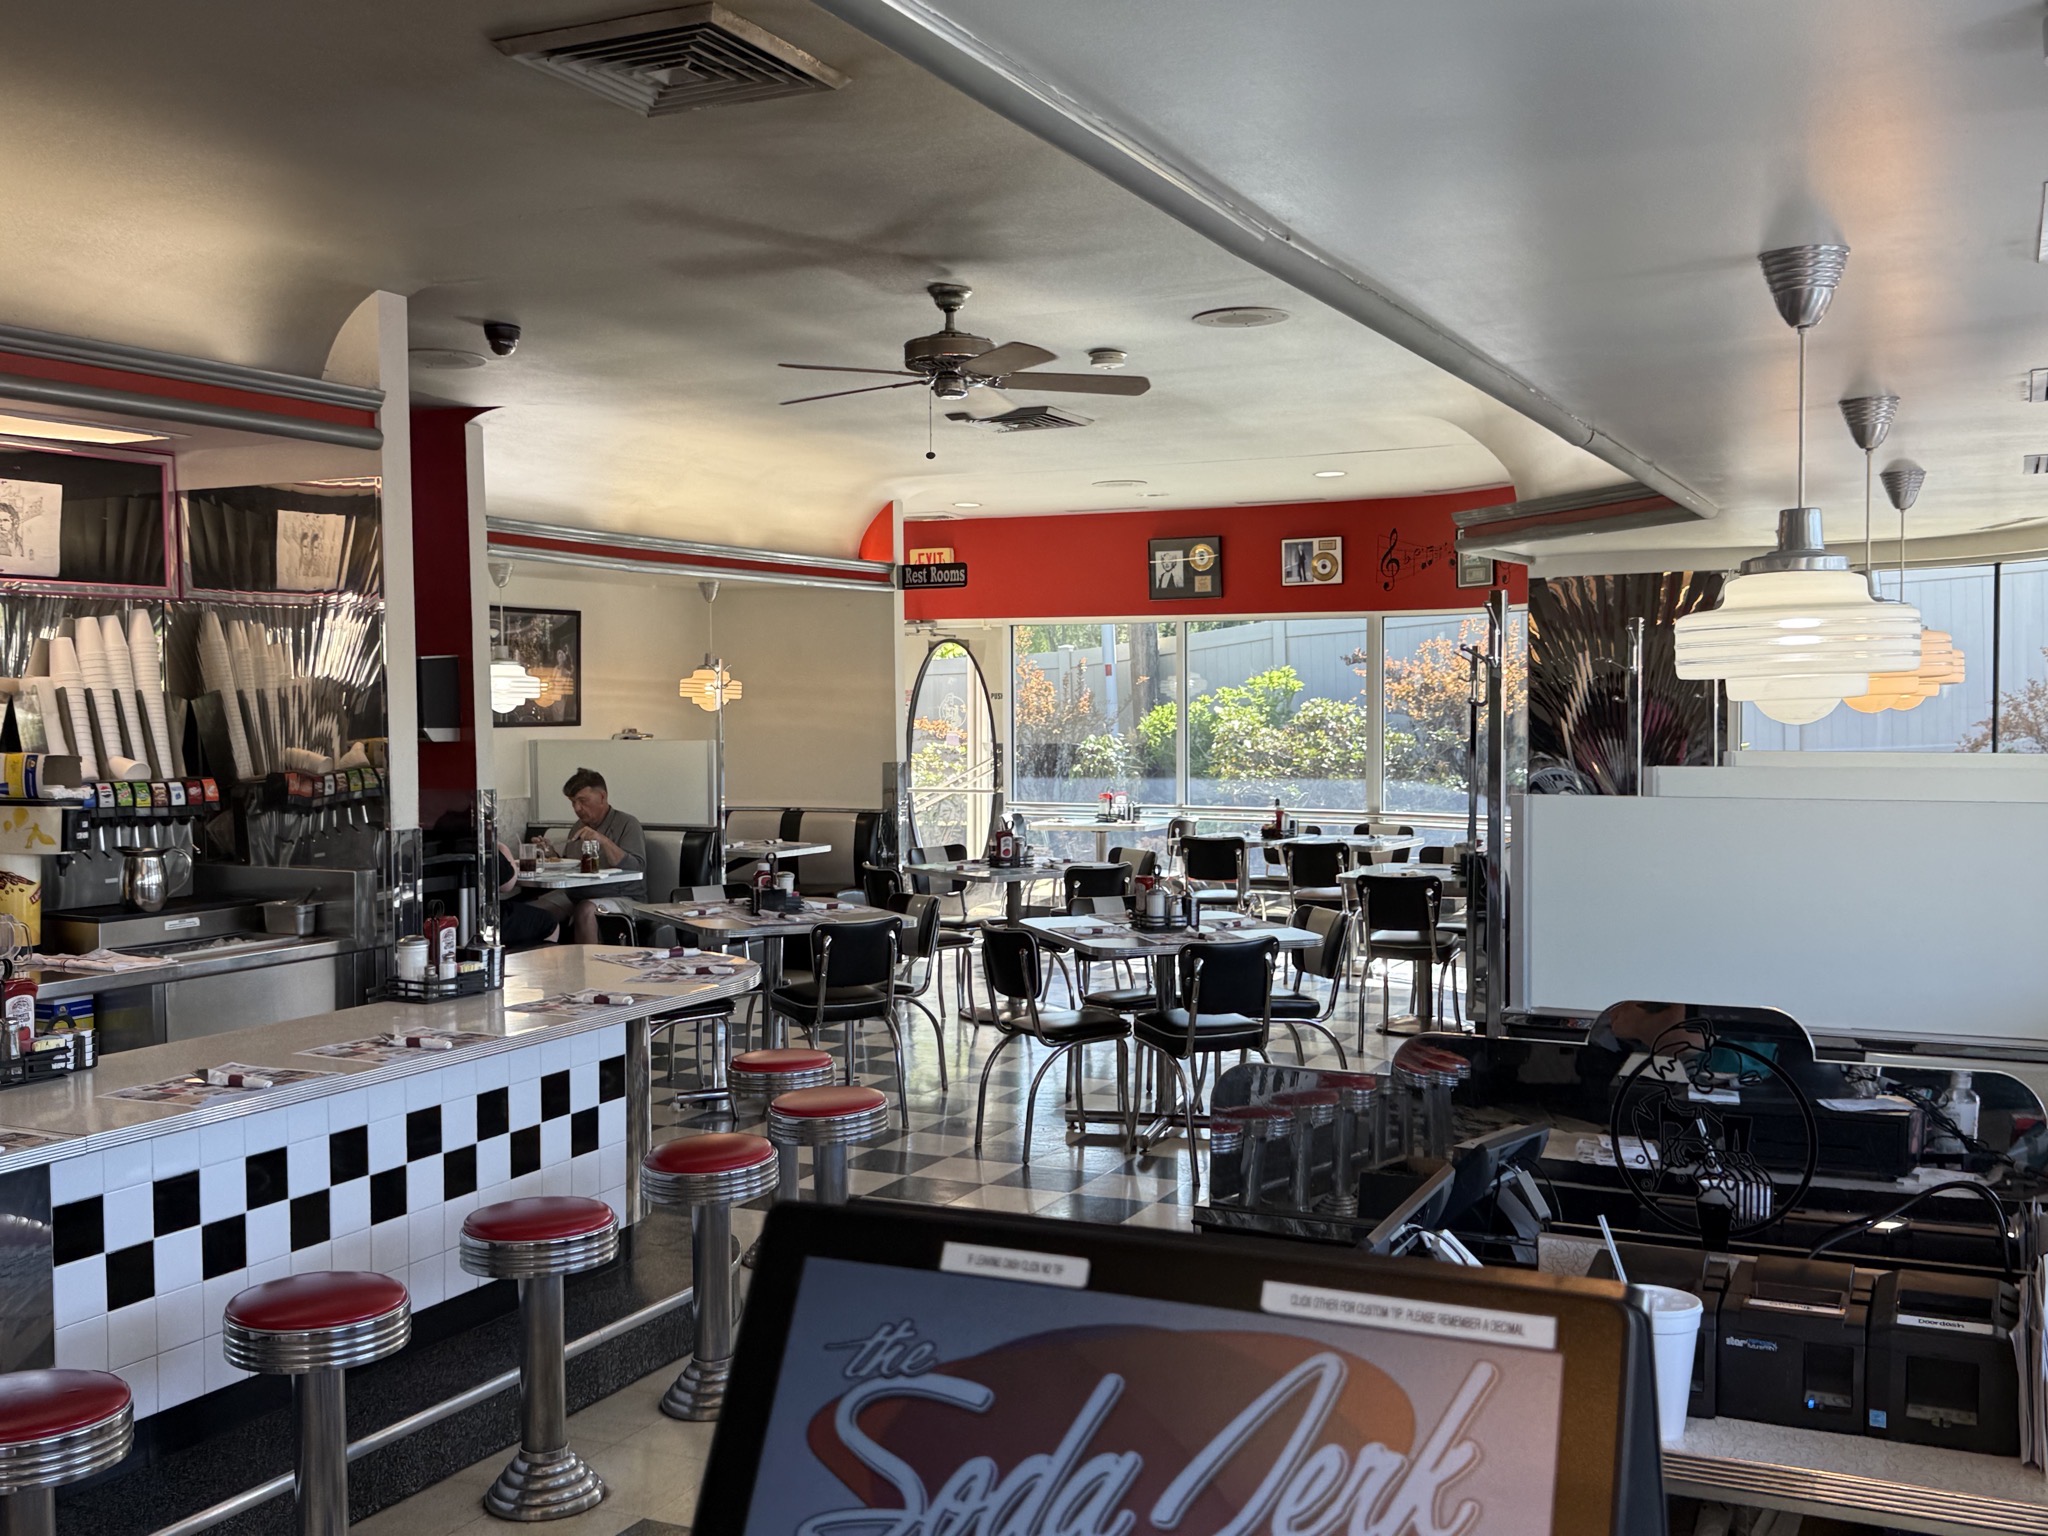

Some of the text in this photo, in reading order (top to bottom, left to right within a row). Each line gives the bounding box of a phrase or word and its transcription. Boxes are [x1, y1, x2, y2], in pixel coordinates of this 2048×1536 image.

[905, 566, 966, 584] Rest Rooms
[823, 1317, 940, 1379] the
[798, 1350, 1499, 1536] Soda Jerk
